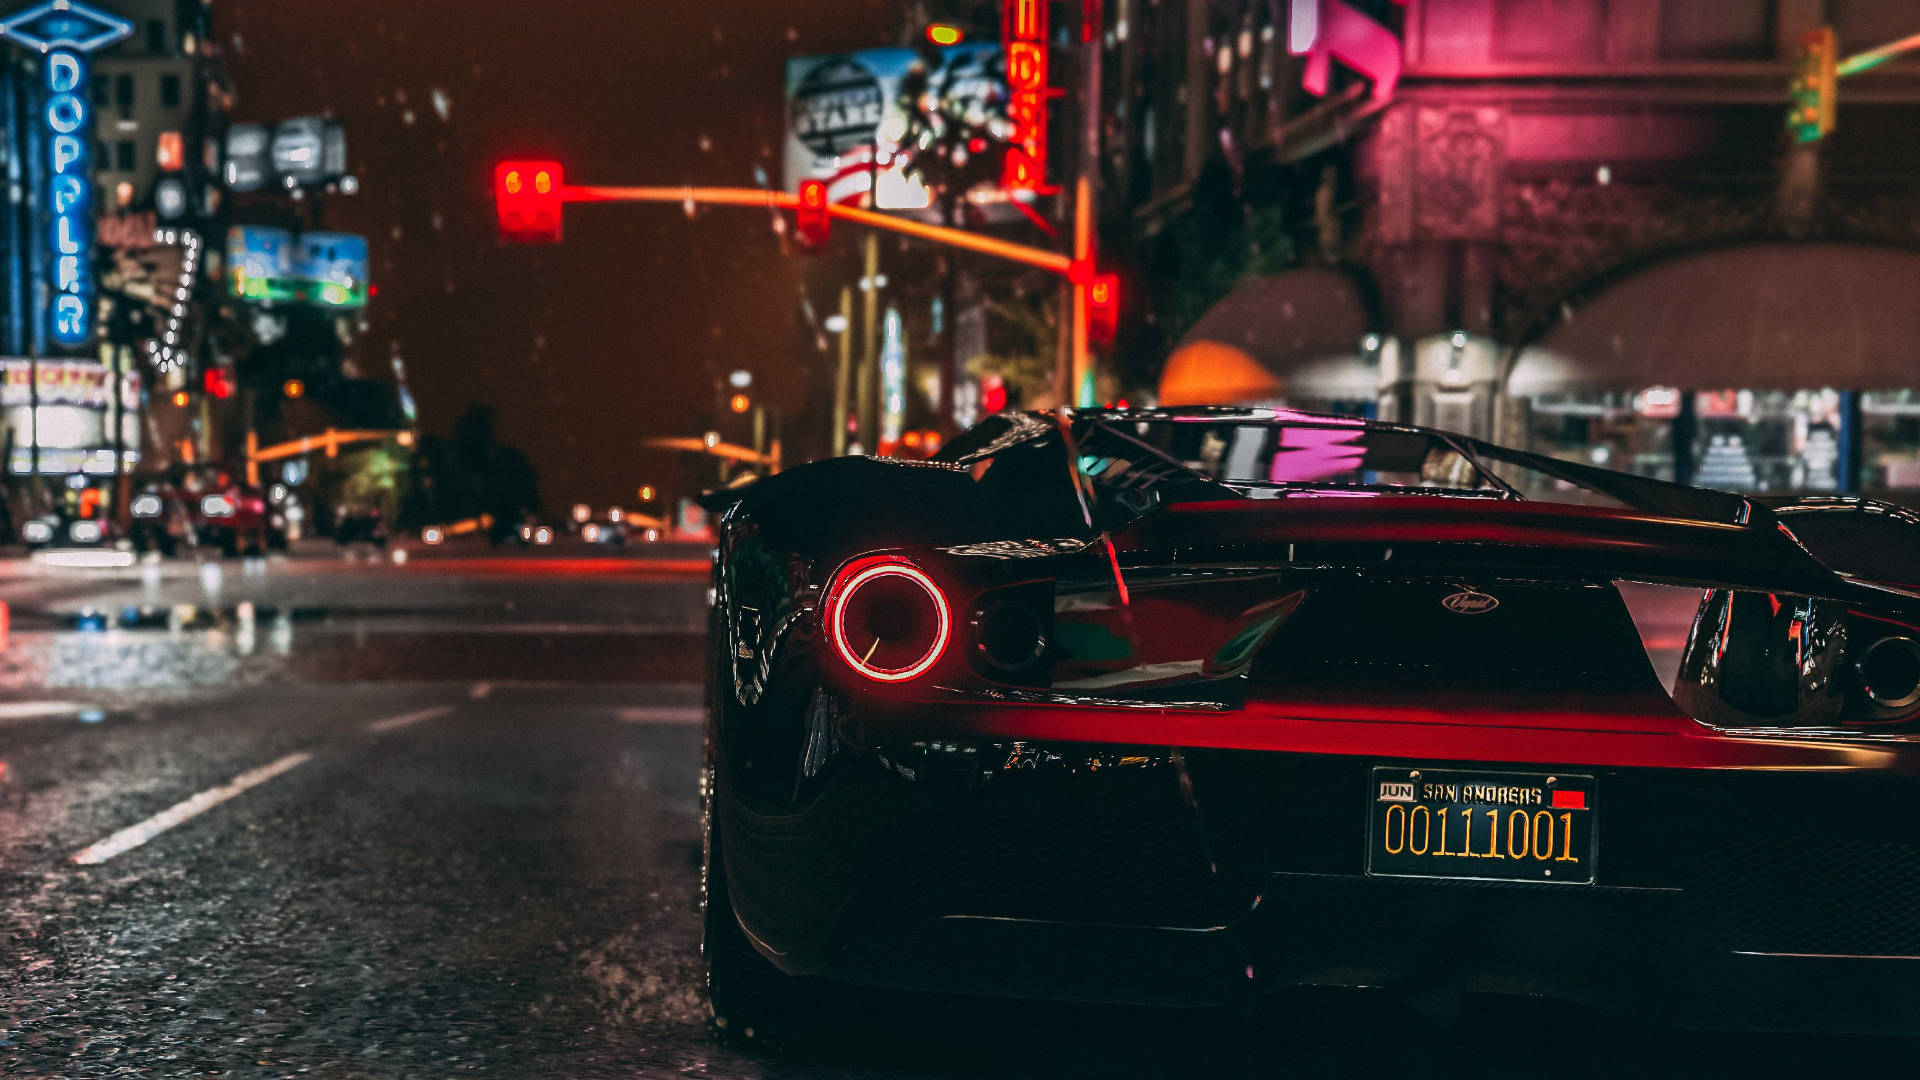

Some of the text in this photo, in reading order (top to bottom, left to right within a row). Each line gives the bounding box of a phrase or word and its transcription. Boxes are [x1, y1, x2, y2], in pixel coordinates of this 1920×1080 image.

[1381, 785, 1412, 797] JUN
[1424, 783, 1458, 803] SAN
[1463, 785, 1542, 805] ANDREAS
[1385, 804, 1578, 863] 00111001
